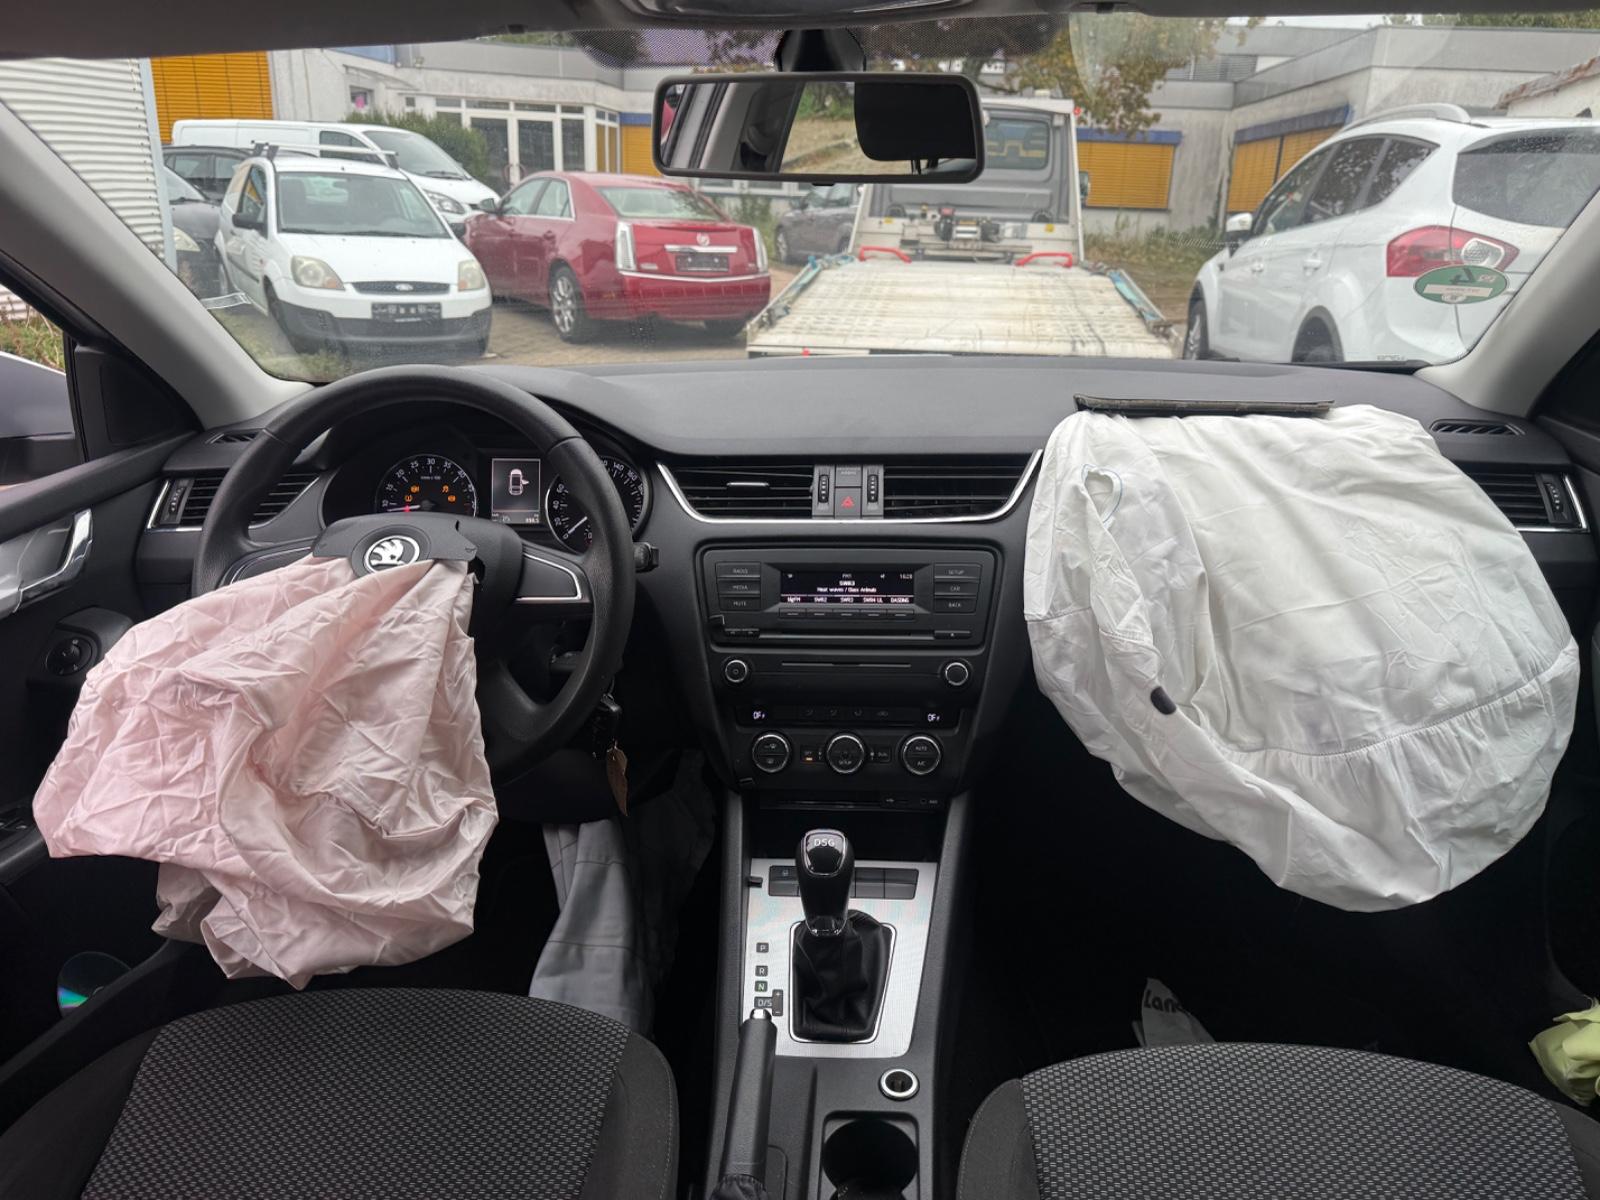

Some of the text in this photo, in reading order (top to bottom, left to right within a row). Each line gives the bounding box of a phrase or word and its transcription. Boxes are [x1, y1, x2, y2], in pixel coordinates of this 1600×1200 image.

[396, 469, 405, 478] 20
[814, 838, 835, 847] DSG
[757, 999, 772, 1007] D/S
